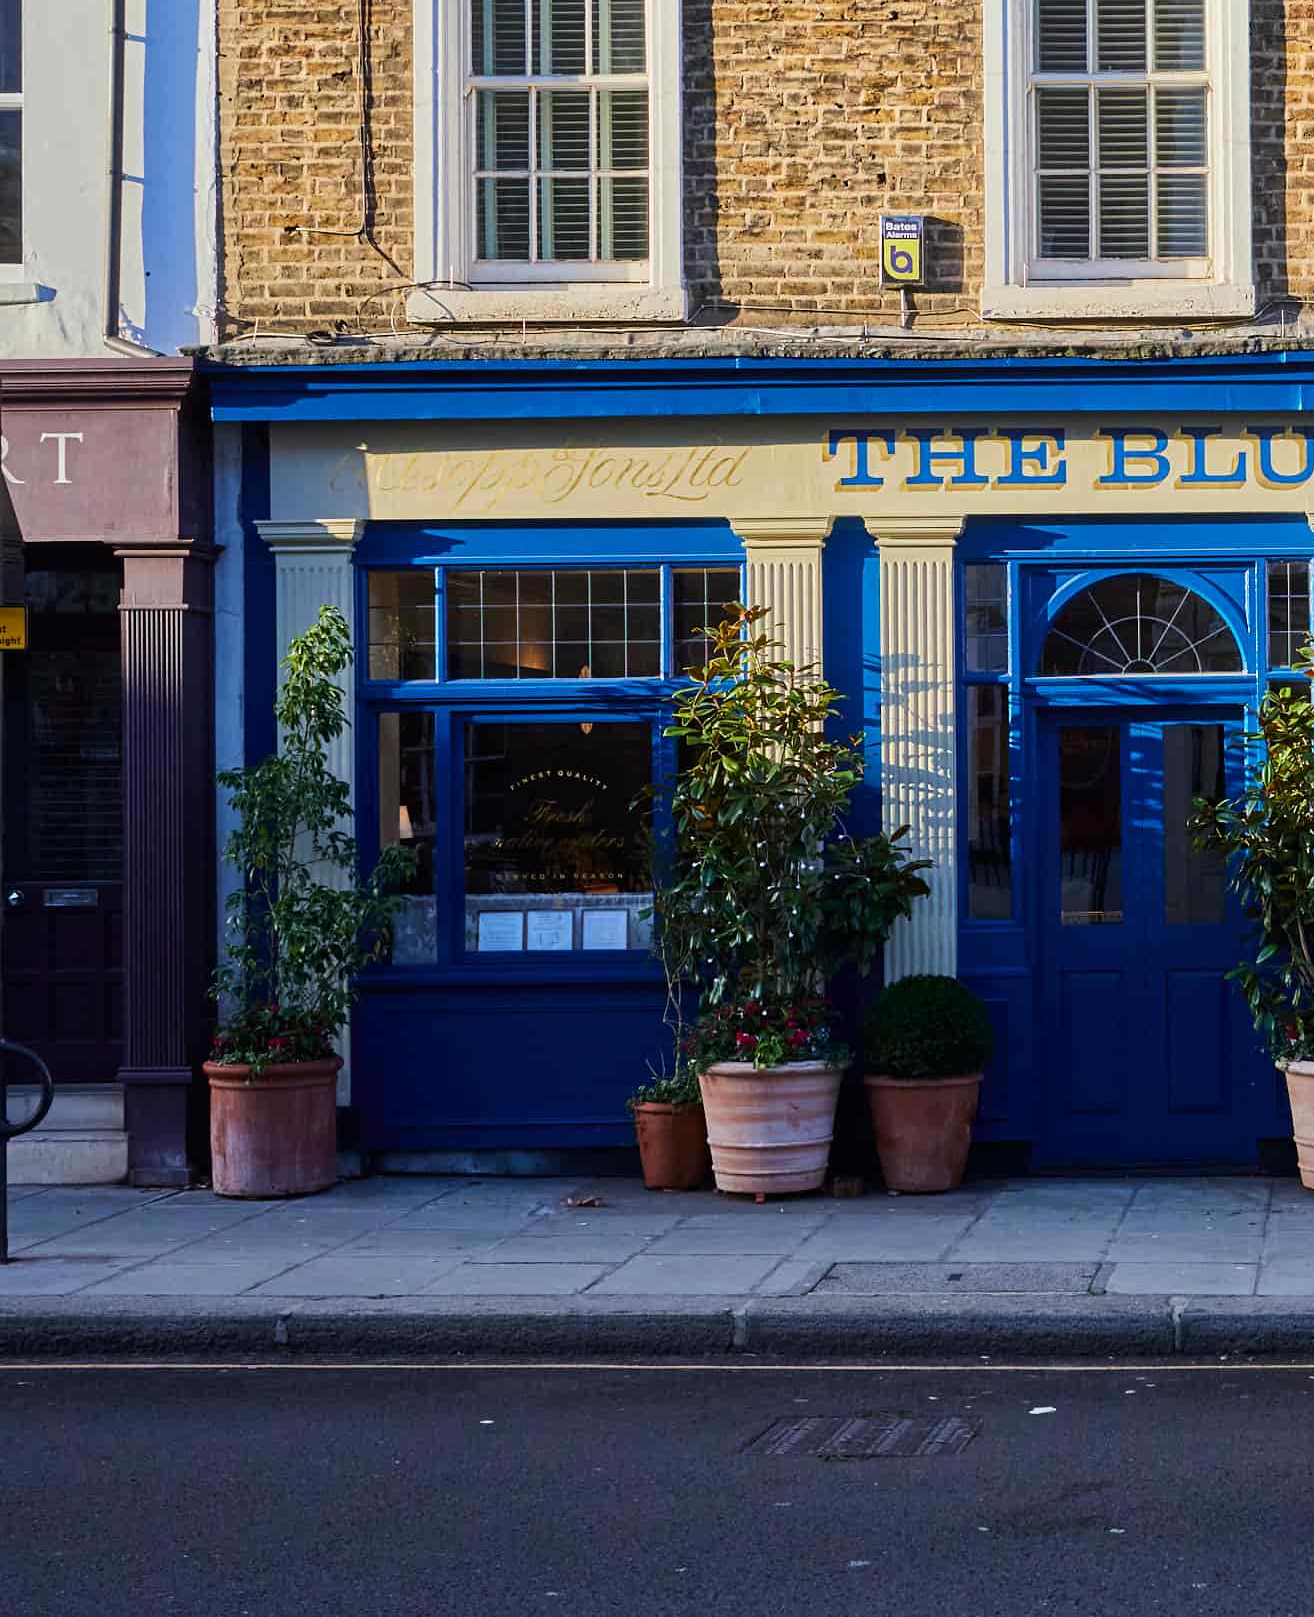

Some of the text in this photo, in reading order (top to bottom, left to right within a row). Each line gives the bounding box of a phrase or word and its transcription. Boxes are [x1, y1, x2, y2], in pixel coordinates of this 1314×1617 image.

[886, 222, 917, 231] Bates
[822, 427, 1066, 492] THE
[509, 768, 609, 791] FINEST QUALITY
